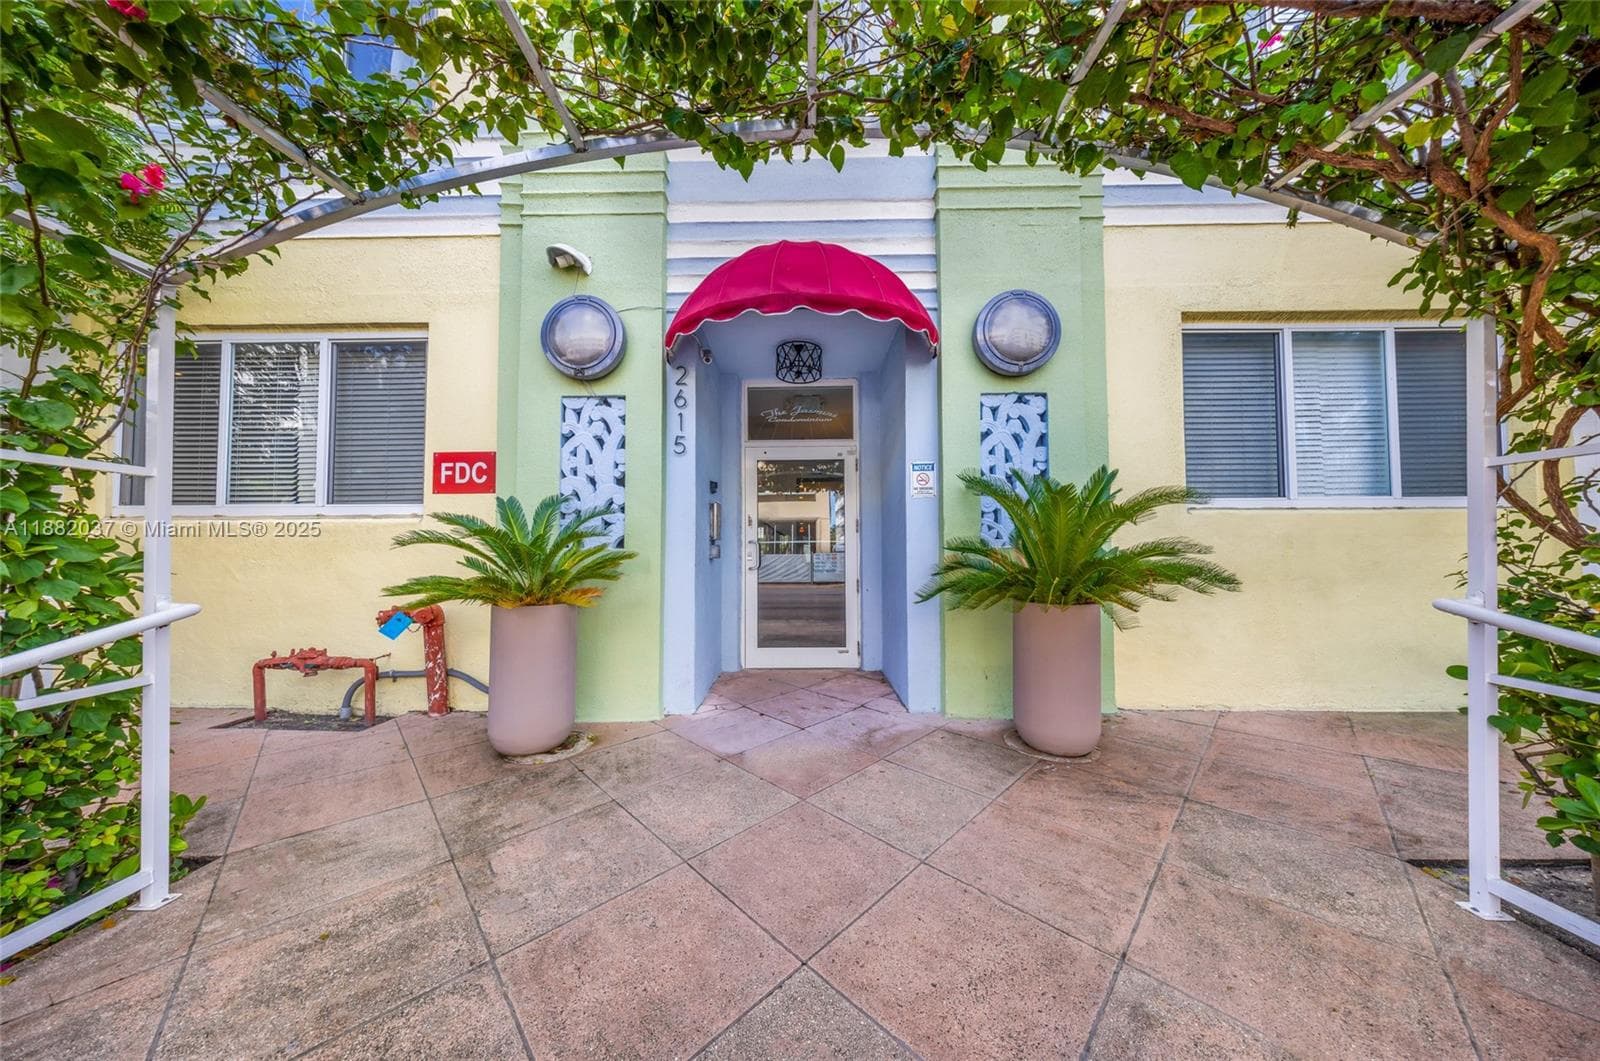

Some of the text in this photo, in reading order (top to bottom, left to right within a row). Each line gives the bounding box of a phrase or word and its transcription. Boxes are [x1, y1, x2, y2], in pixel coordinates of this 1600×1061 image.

[674, 366, 688, 455] 2615
[760, 408, 788, 418] The
[440, 461, 488, 484] FDC
